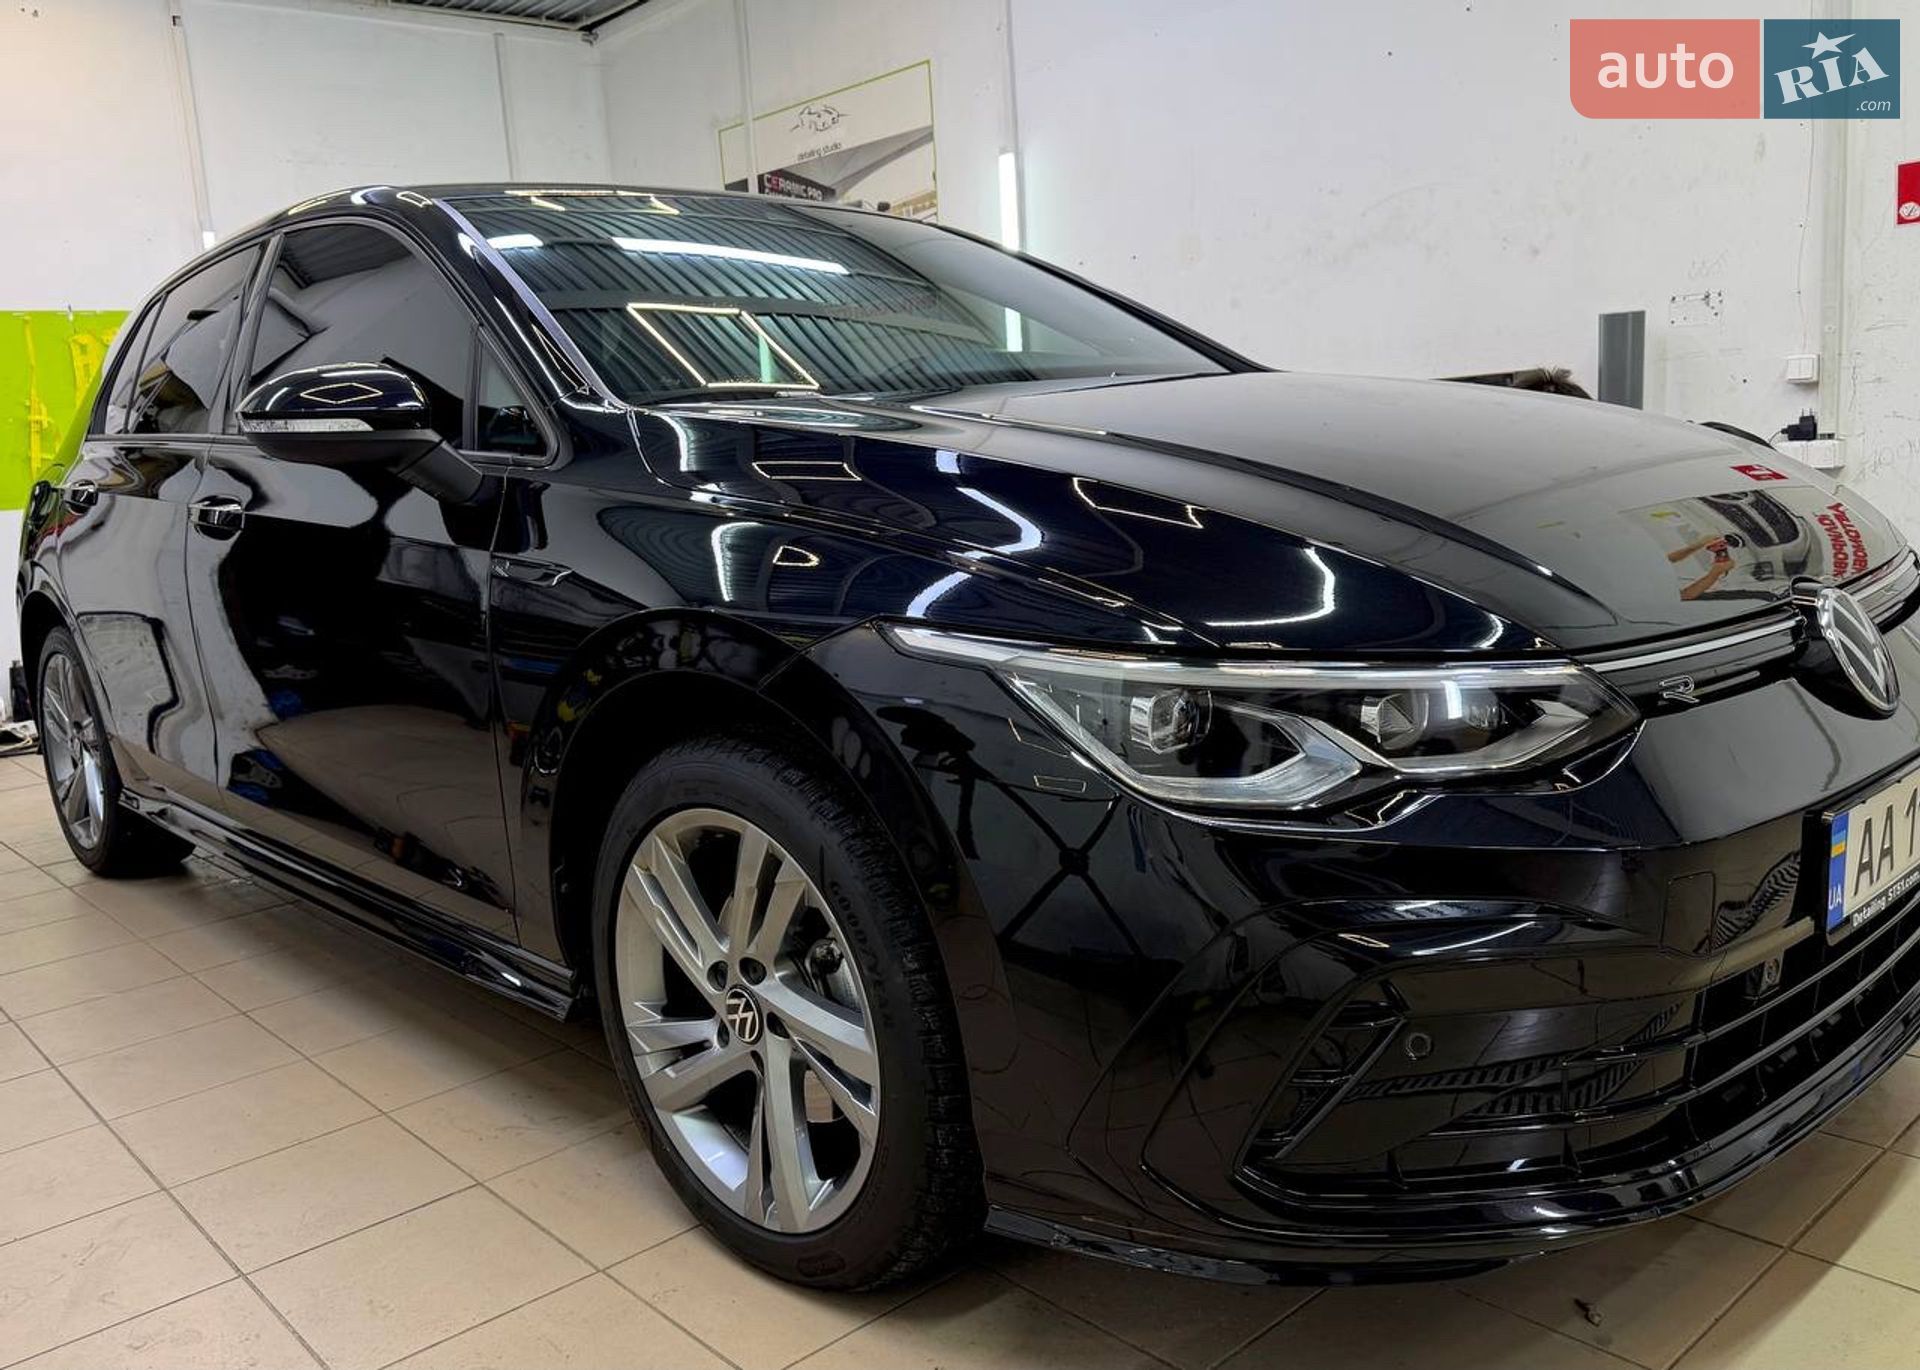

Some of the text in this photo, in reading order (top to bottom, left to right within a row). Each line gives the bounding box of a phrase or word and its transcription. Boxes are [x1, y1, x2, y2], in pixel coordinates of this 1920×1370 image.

[1852, 786, 1920, 897] AA 1
[1828, 882, 1843, 911] UA
[1852, 896, 1887, 927] Detailing
